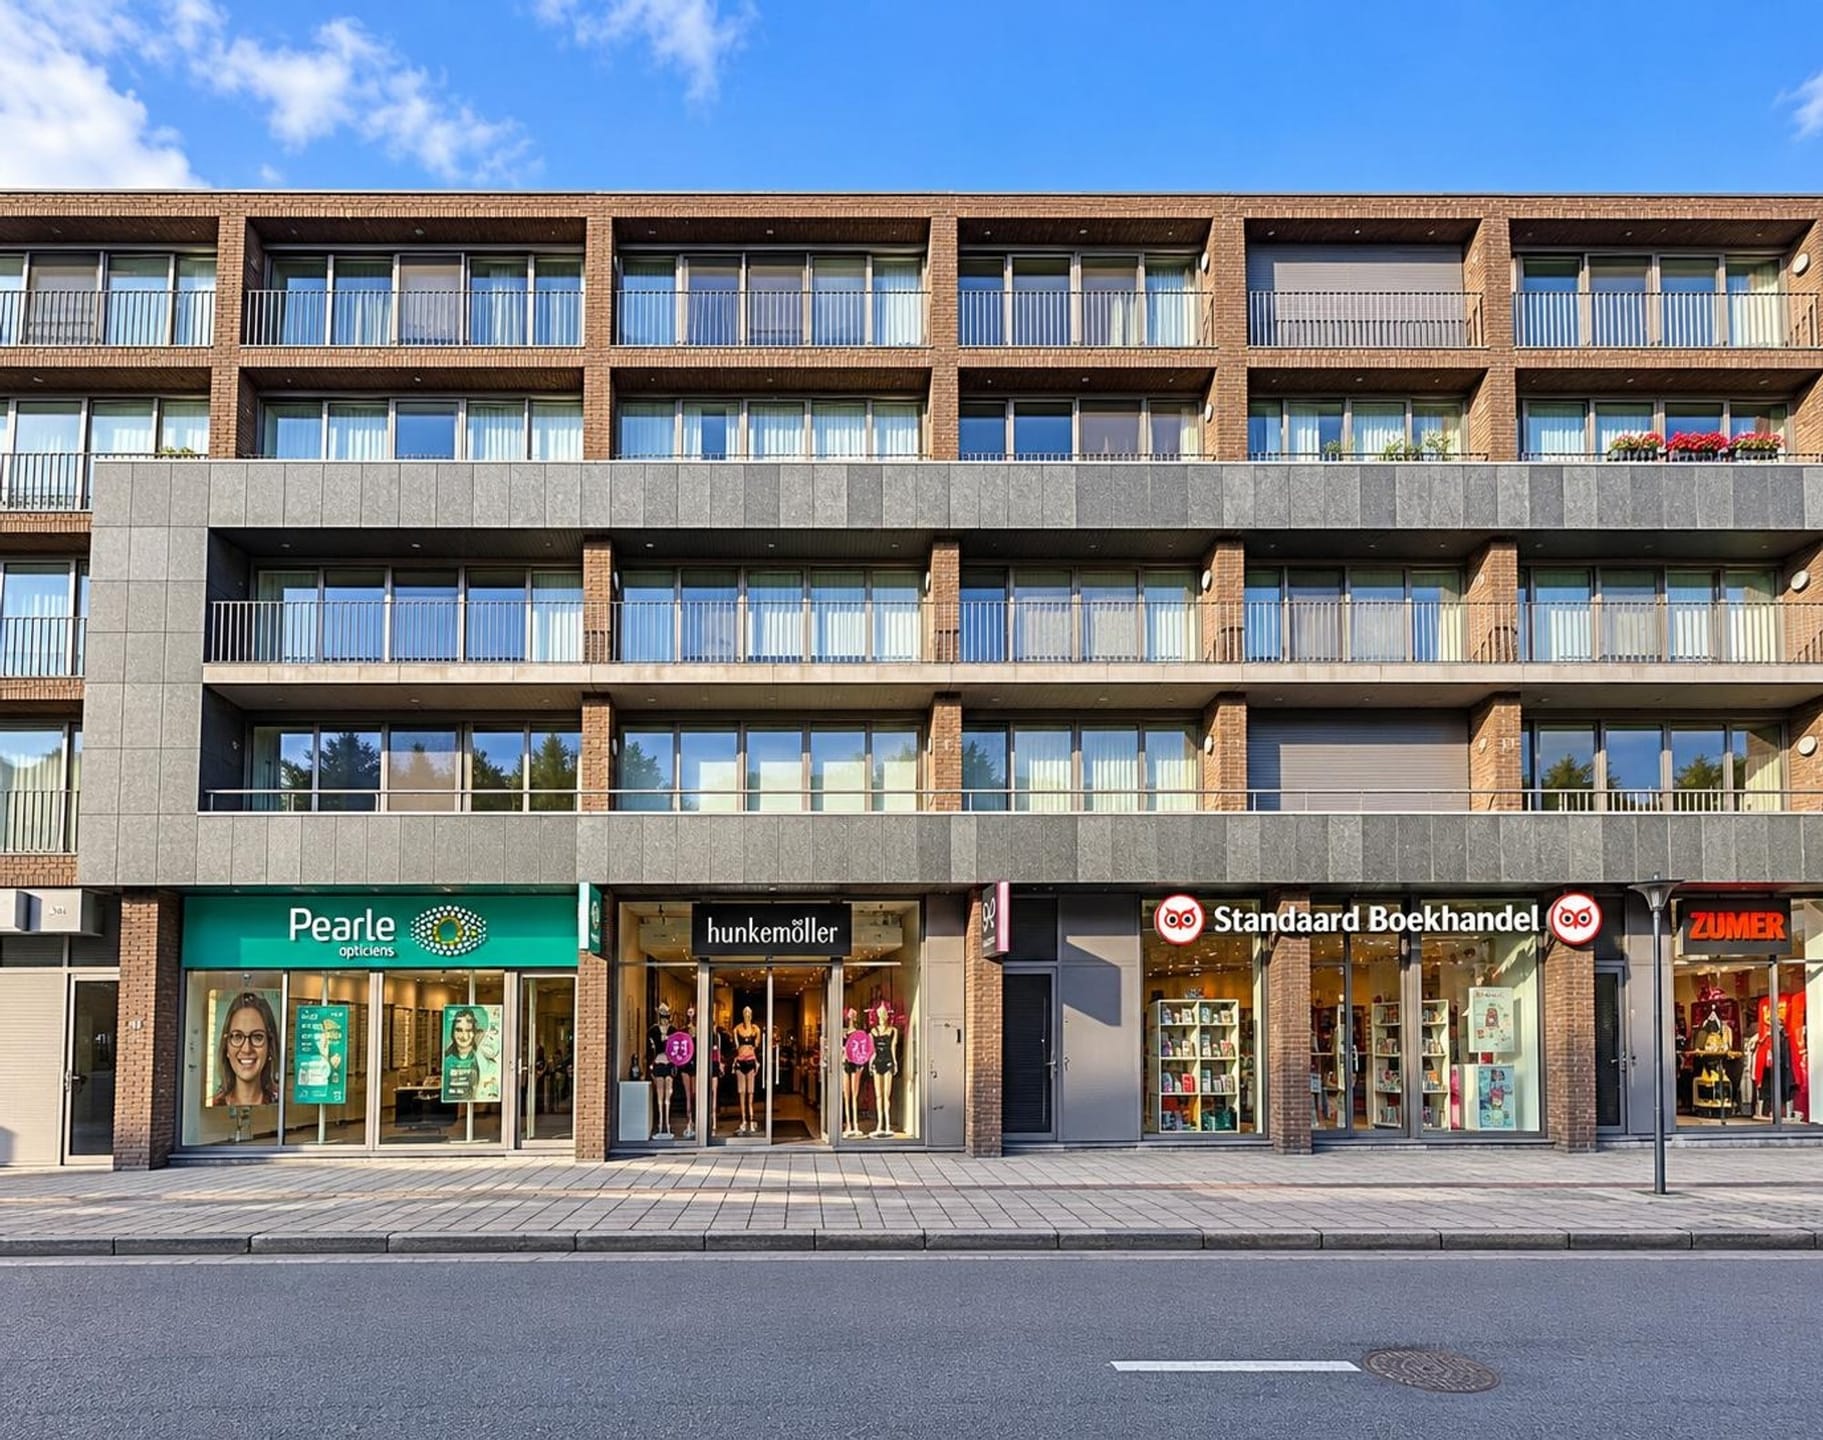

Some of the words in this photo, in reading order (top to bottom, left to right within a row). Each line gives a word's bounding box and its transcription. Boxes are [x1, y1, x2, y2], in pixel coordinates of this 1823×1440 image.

[289, 907, 396, 942] Pearle
[707, 916, 839, 944] hunkemöller
[1214, 905, 1360, 933] Standaard
[1368, 904, 1540, 933] Boekhandel
[1688, 912, 1787, 940] ZUMER
[339, 944, 396, 960] opticiens
